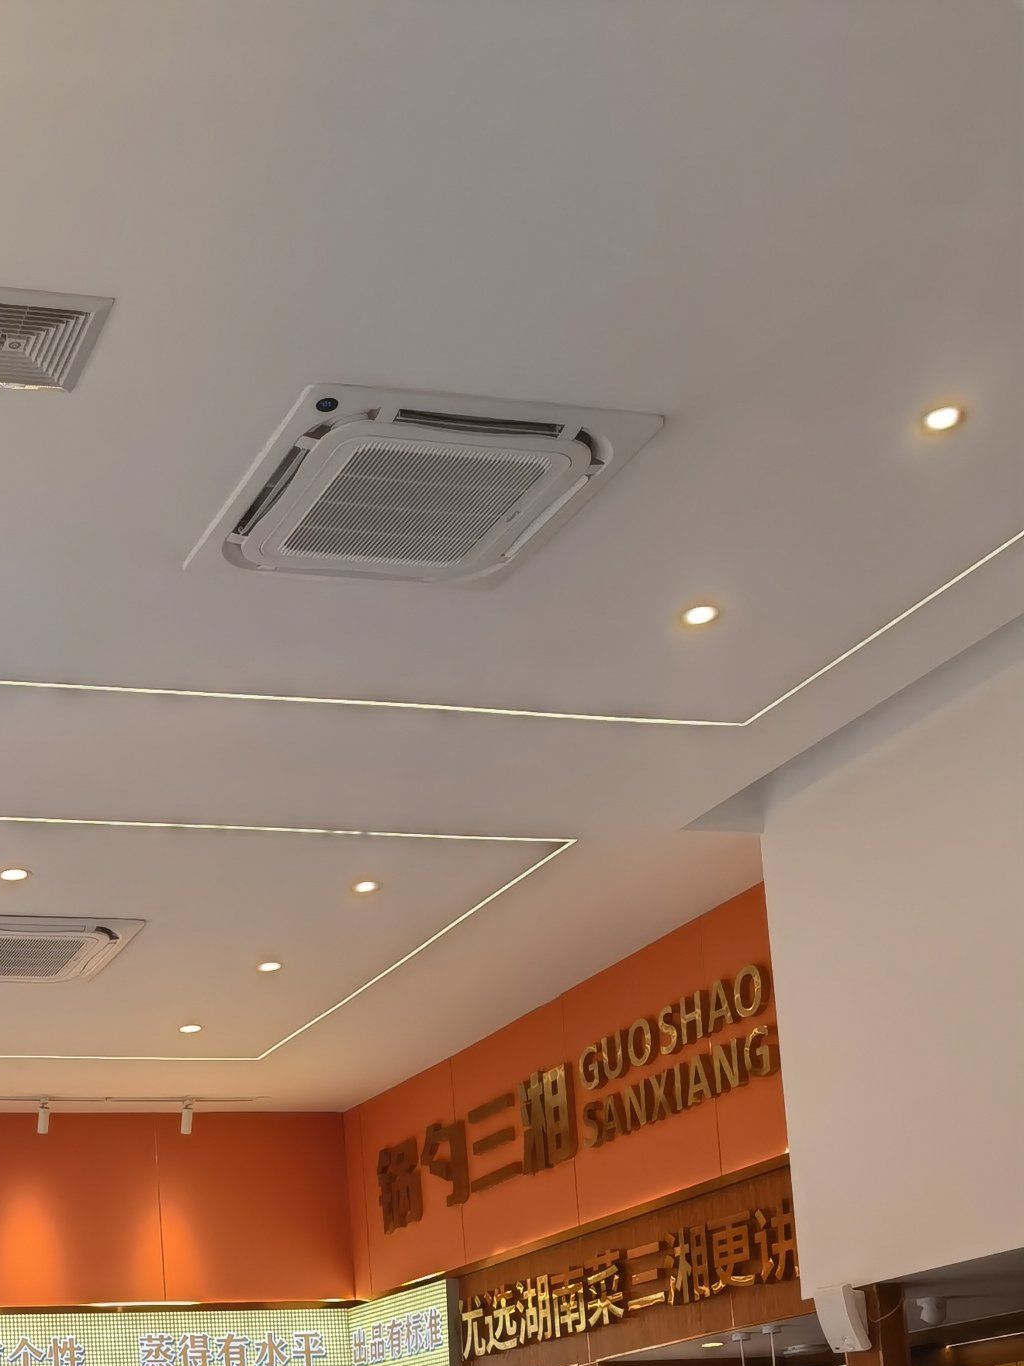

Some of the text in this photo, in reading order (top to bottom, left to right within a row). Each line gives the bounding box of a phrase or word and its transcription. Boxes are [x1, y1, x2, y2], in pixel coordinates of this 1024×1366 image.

[579, 963, 767, 1090] GUOSHAO
[582, 1024, 775, 1149] SANXIANG
[376, 1062, 577, 1235] 锅勺三湘
[352, 1308, 444, 1366] 出品有标准
